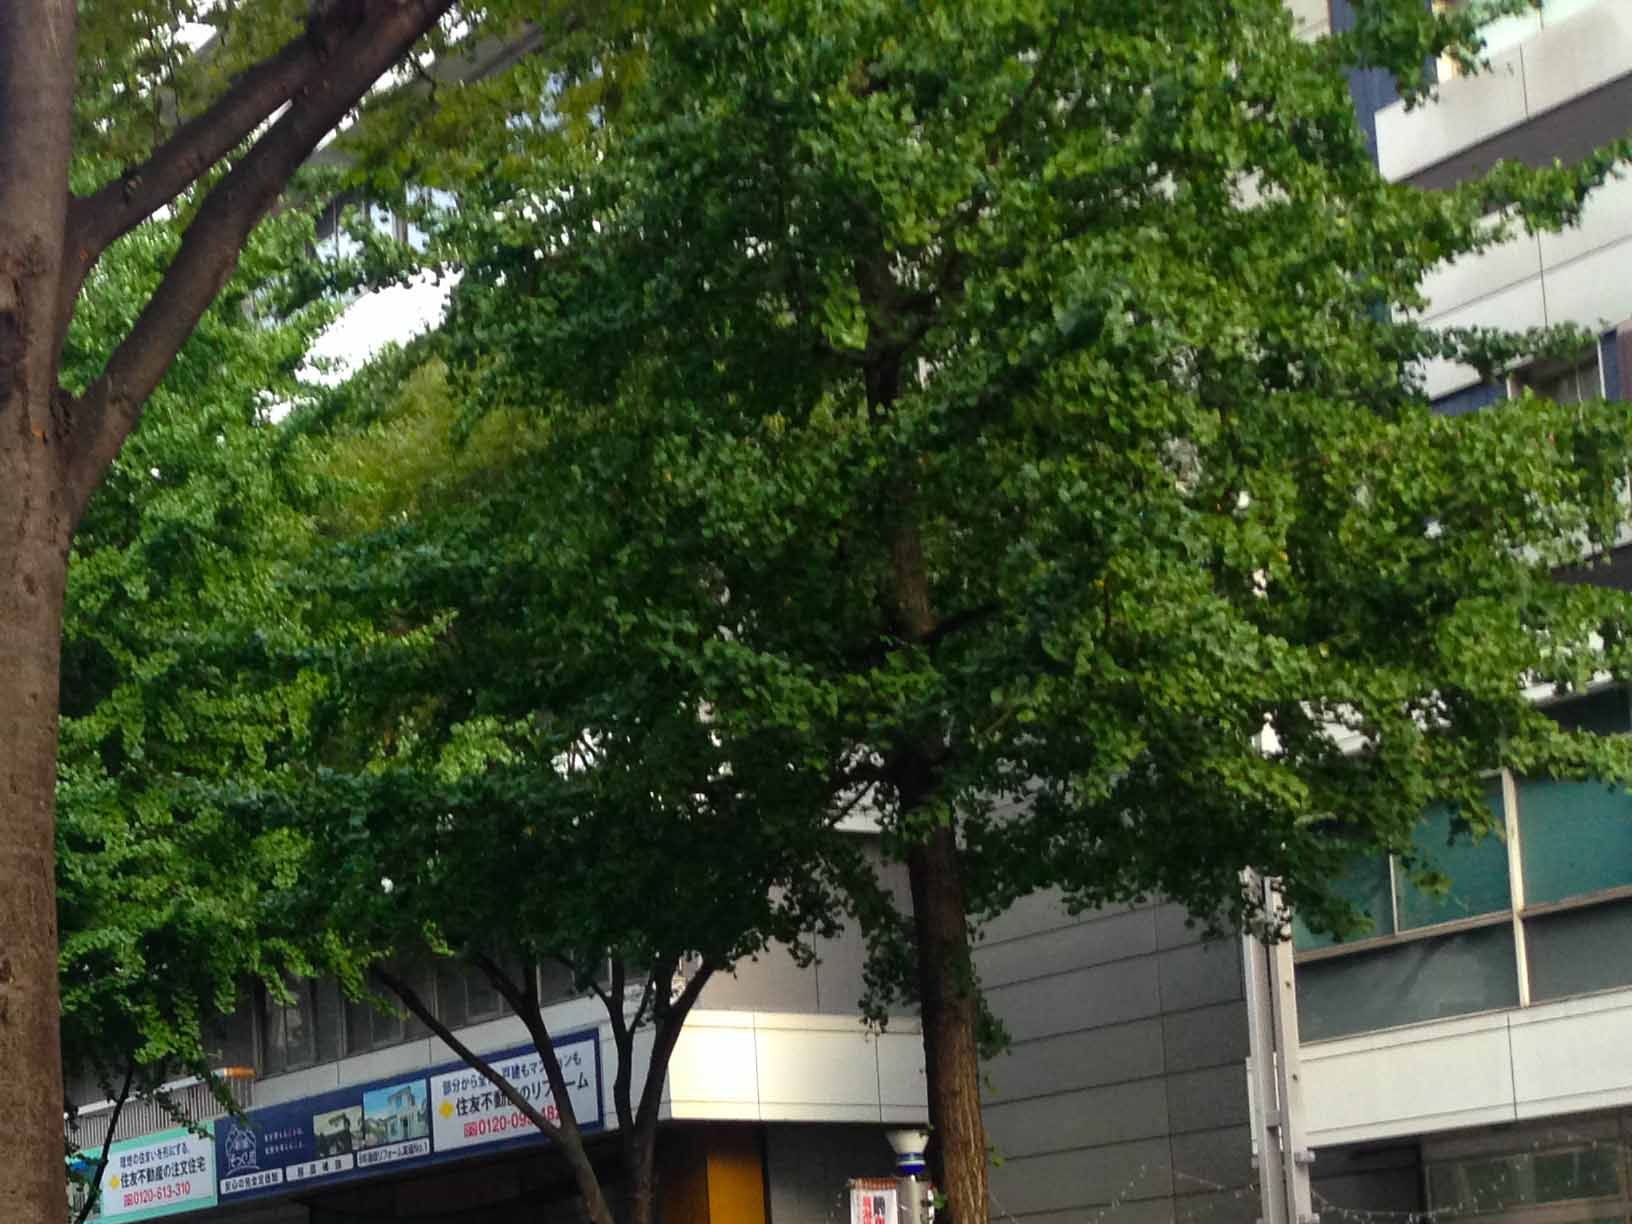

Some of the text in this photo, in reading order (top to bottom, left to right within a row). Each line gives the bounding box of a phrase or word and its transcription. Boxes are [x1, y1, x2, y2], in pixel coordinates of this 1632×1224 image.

[456, 1072, 589, 1117] 住友不動のリフーム
[120, 1156, 207, 1189] 住友不動産の注文住宅
